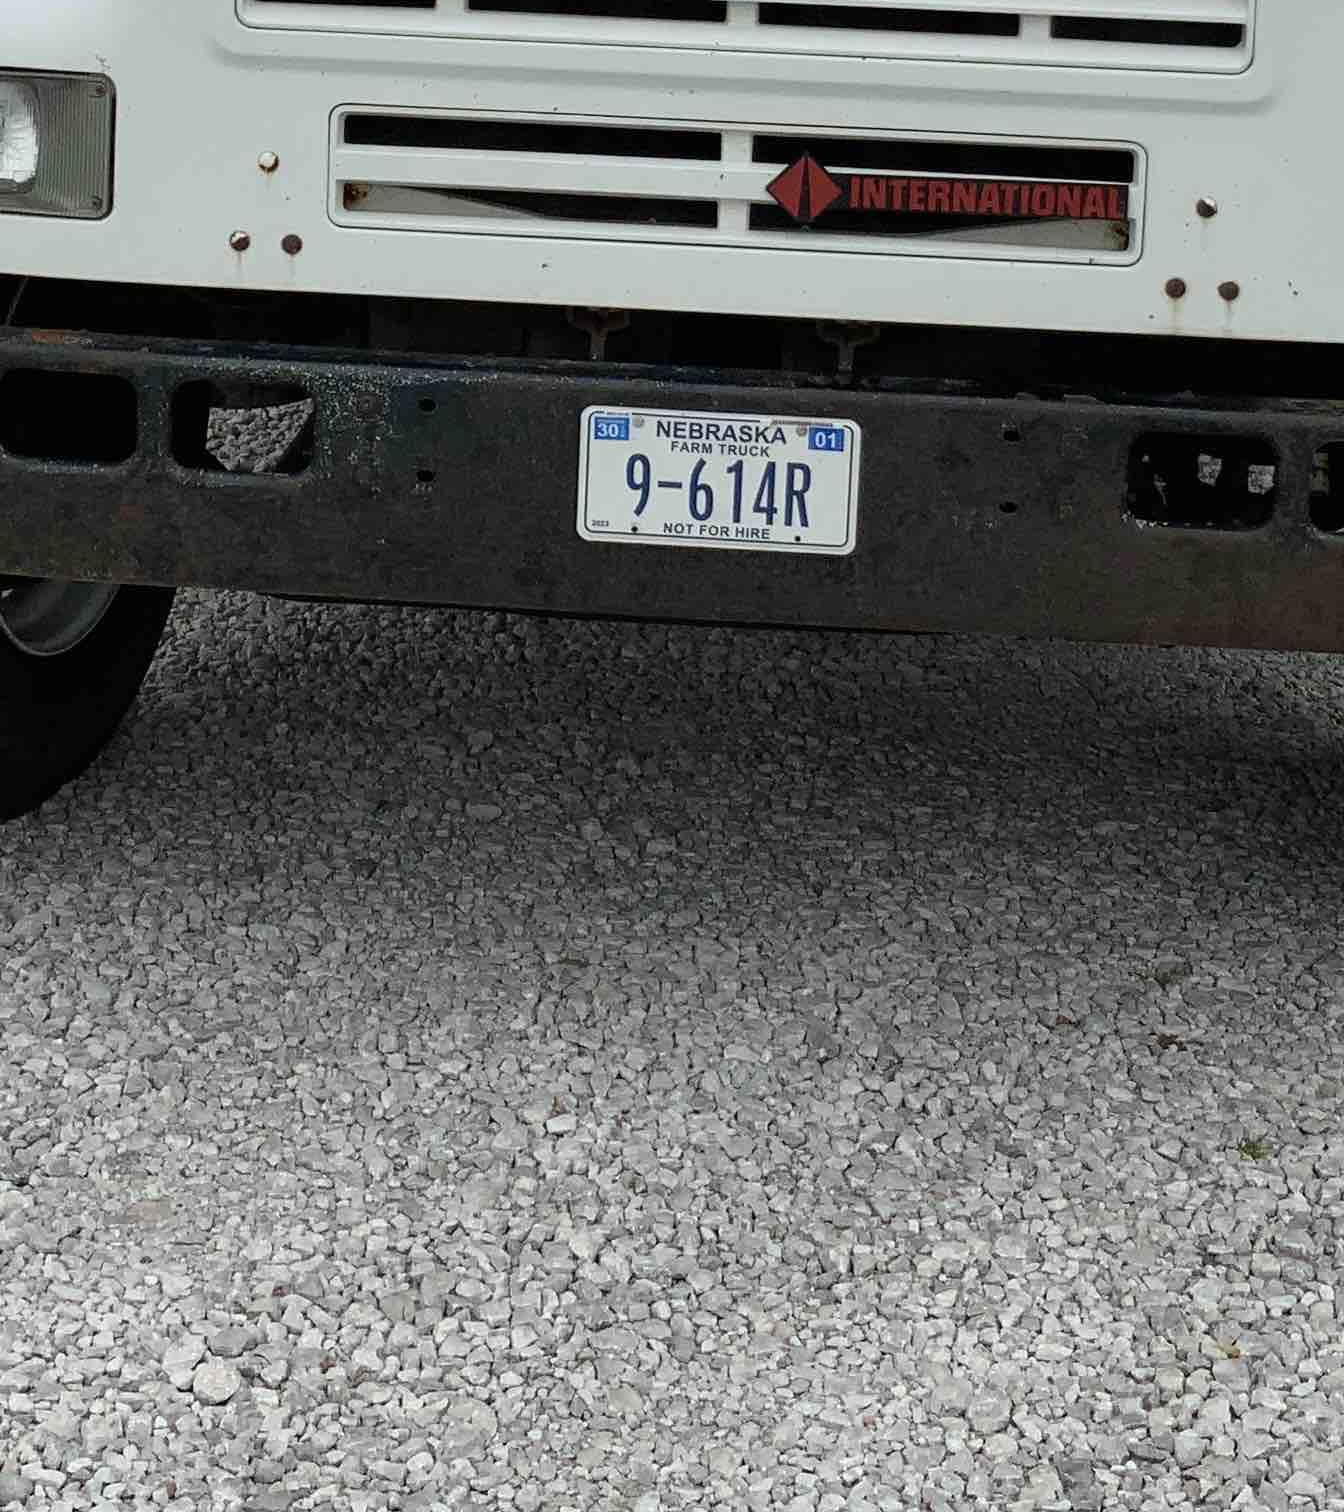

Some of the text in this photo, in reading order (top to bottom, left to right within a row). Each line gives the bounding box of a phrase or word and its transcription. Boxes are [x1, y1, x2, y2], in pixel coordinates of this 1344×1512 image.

[848, 176, 1123, 219] INTERNATIONAL
[597, 422, 619, 438] 30
[656, 420, 787, 445] NEBRASKA
[816, 430, 836, 448] 01
[671, 440, 770, 458] FARM TRUCK
[626, 453, 811, 529] 9-614R
[663, 522, 771, 540] NOT FOR HIRE
